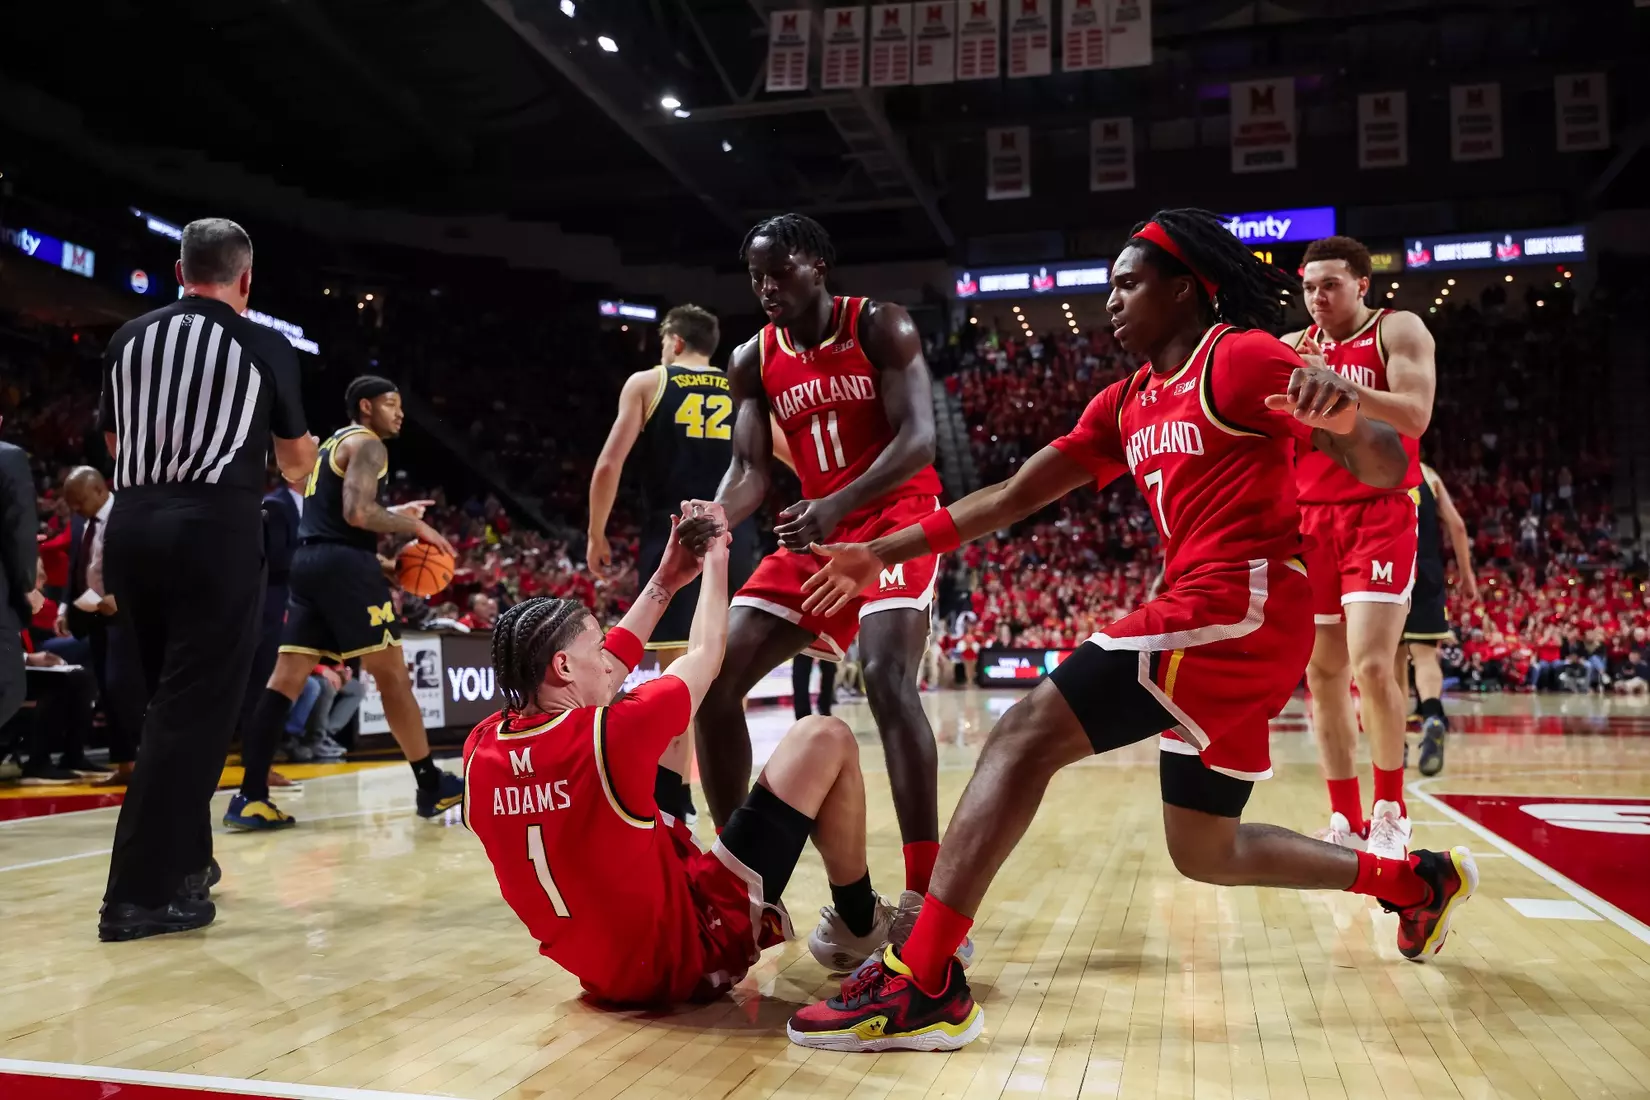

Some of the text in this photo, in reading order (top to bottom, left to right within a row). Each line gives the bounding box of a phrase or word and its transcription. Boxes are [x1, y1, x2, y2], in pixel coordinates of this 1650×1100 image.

[1223, 215, 1292, 240] finity
[671, 374, 730, 391] TSCHETTE
[675, 392, 732, 440] 42
[811, 411, 846, 472] 11
[1126, 421, 1205, 476] ARYLAND
[1144, 468, 1172, 540] 7
[879, 563, 906, 589] M
[1371, 559, 1394, 583] M
[367, 600, 395, 627] M
[447, 667, 495, 702] YOU
[508, 747, 535, 776] M
[493, 779, 572, 816] ADAMS
[527, 824, 572, 918] 1
